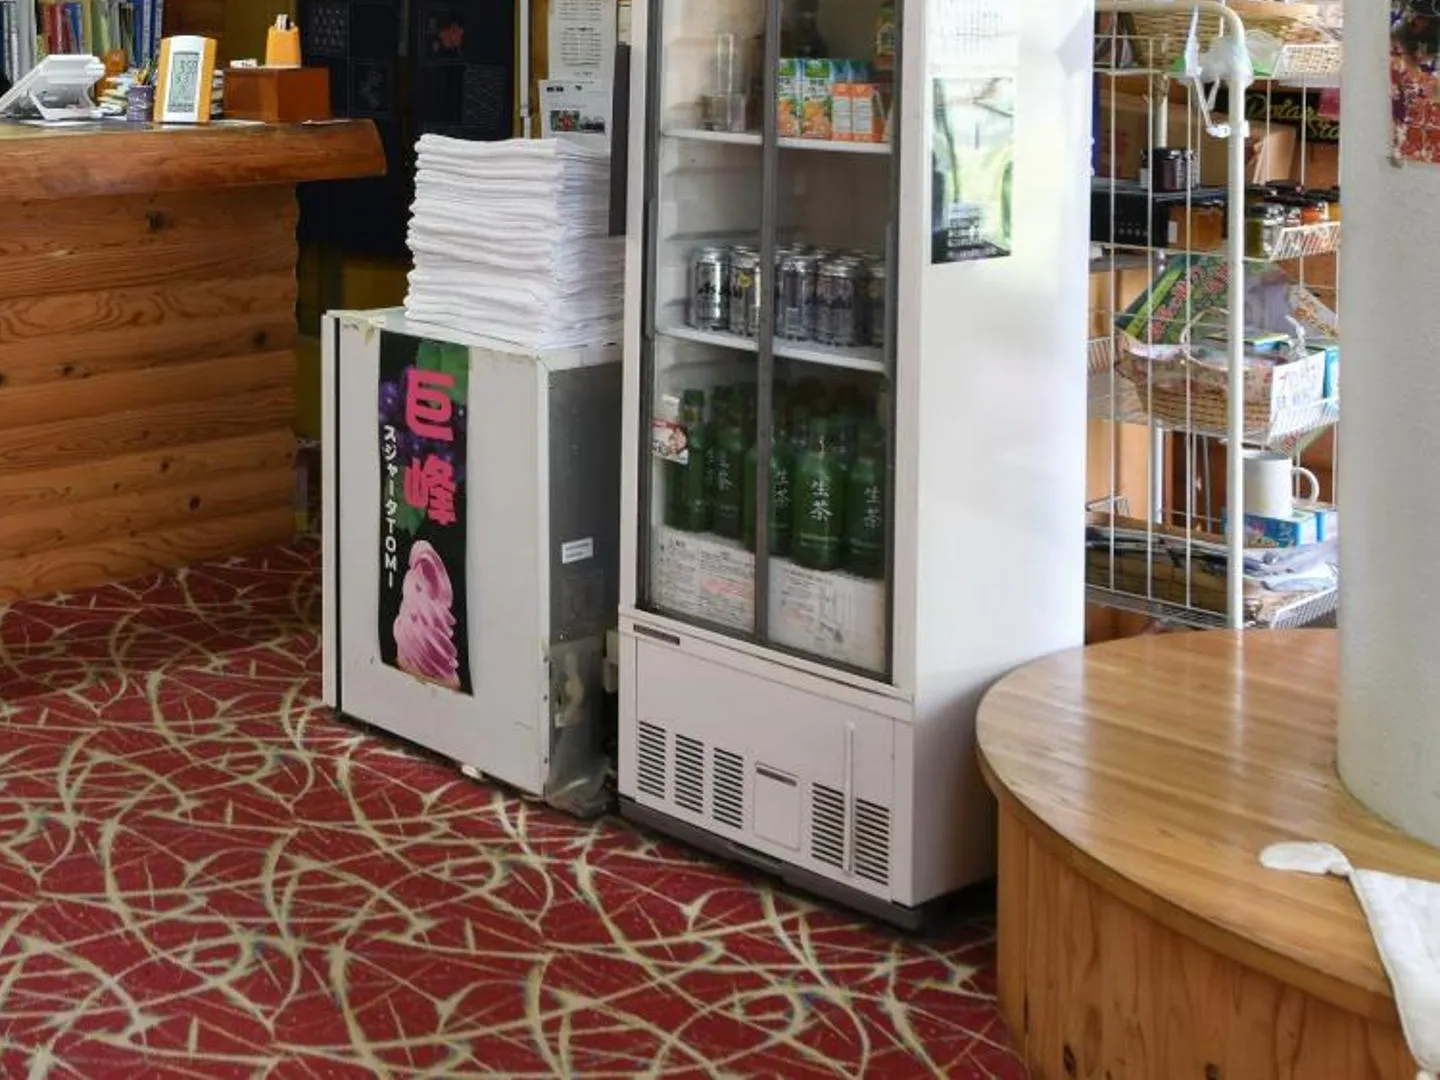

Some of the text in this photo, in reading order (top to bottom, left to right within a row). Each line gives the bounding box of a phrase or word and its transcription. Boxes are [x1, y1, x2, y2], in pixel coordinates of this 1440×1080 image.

[381, 425, 398, 589] スジャータTOMI
[405, 366, 457, 526] 巨峰
[811, 479, 834, 522] 生茶
